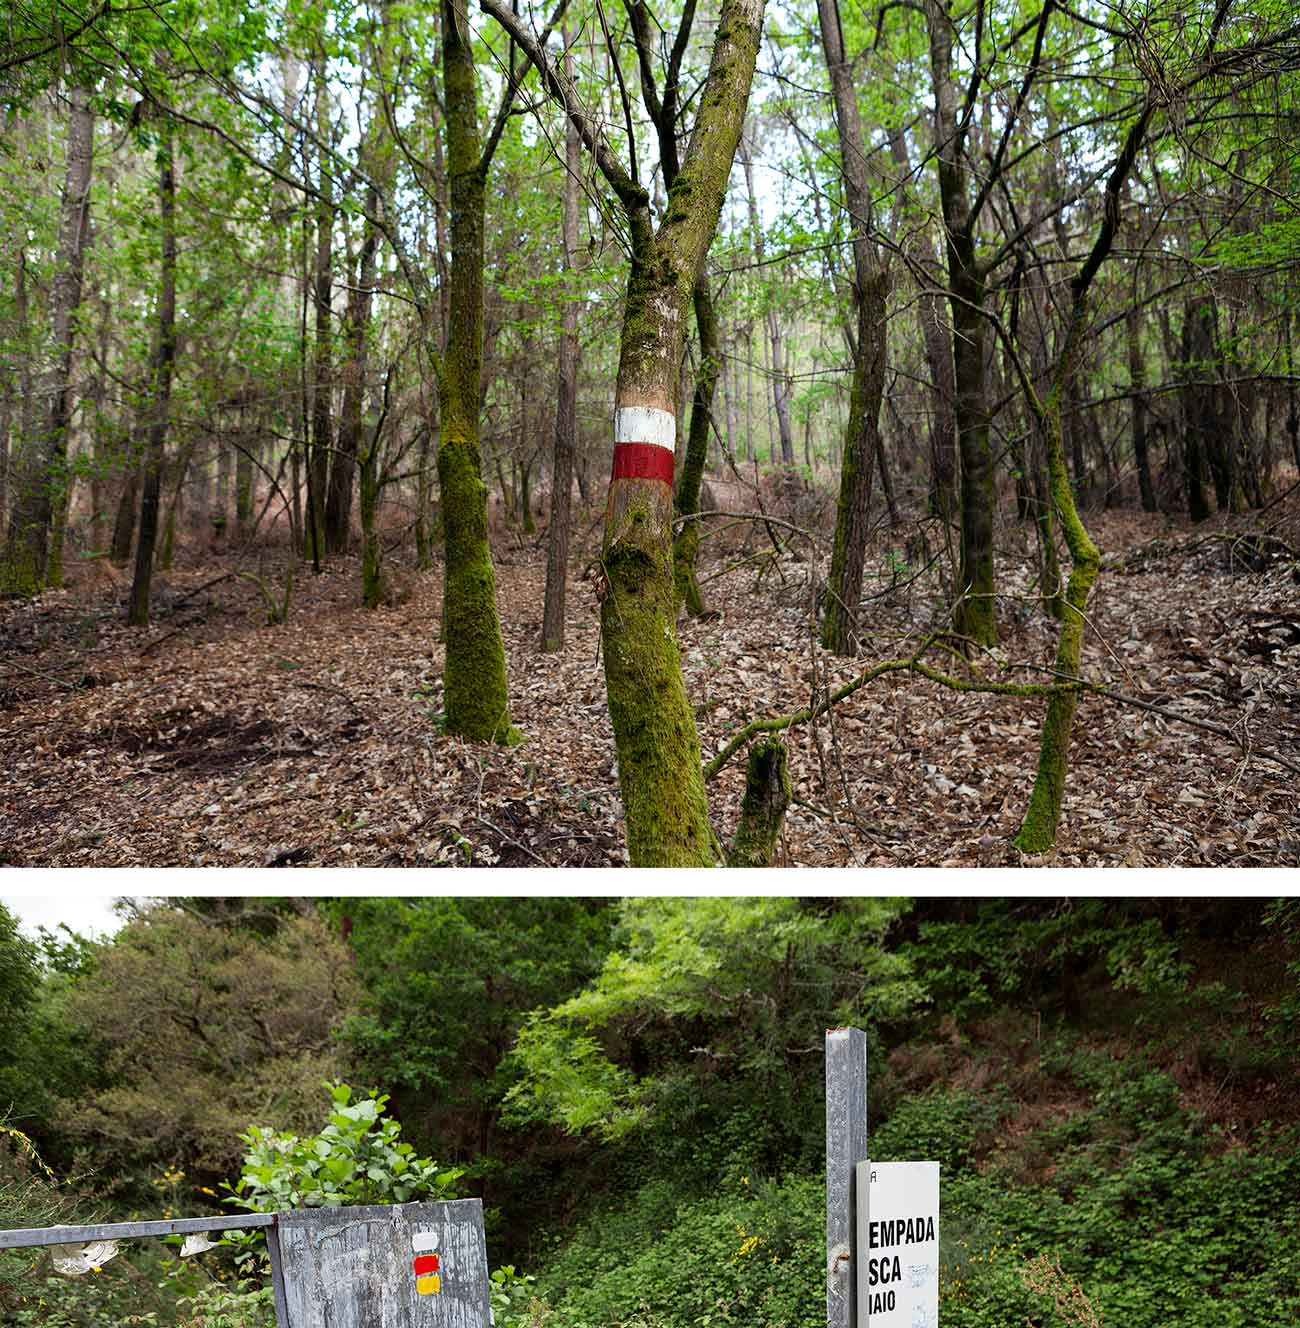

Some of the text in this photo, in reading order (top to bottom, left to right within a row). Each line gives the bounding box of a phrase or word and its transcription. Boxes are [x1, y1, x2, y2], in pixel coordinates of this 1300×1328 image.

[869, 1216, 935, 1249] EMPADA
[869, 1255, 902, 1286] SCA
[869, 1290, 896, 1315] AIO
